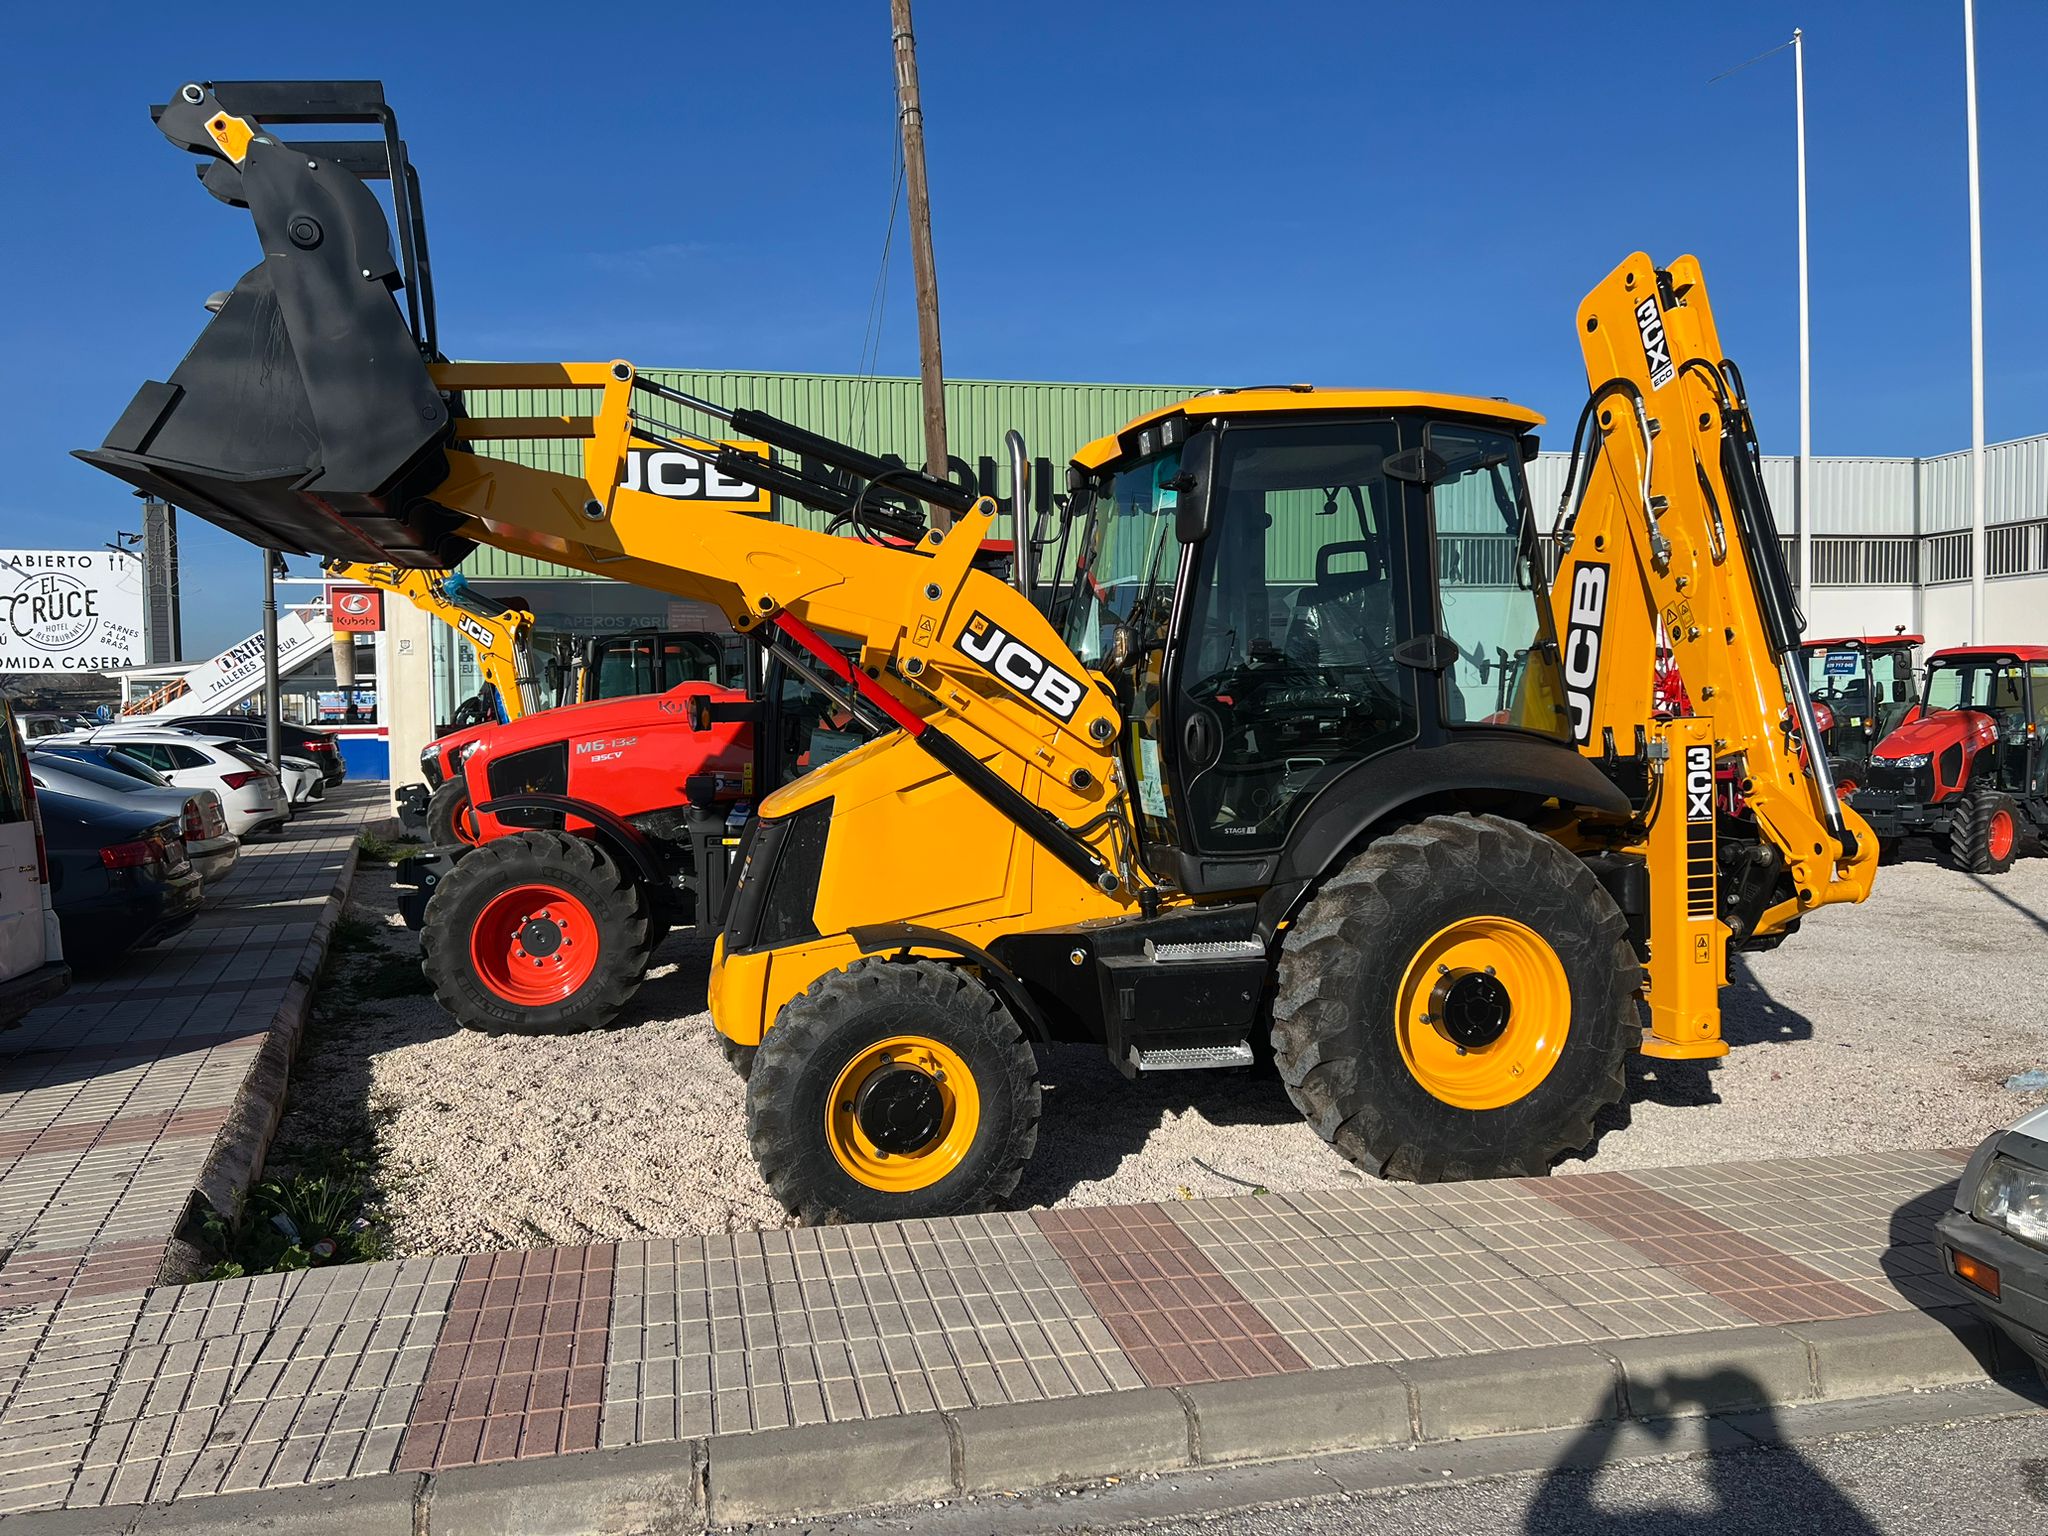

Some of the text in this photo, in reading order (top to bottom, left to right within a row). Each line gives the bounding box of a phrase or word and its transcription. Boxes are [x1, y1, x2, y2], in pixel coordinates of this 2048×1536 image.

[1637, 298, 1670, 373] 3CX
[1653, 368, 1673, 387] ECO
[10, 555, 92, 568] ABIERTO
[40, 575, 60, 595] EL
[1, 588, 99, 637] CRUCE
[336, 616, 376, 626] Kubota
[564, 616, 625, 627] APEROS
[629, 616, 669, 628] AGRI
[35, 621, 86, 643] RESTAURANTE
[45, 622, 69, 632] HOTEL
[103, 620, 140, 638] CARNES
[458, 617, 494, 648] JCB
[100, 636, 130, 652] BRASA
[115, 633, 127, 642] LA
[230, 633, 265, 659] INTER
[0, 656, 133, 669] MIDA CASERA
[235, 642, 266, 664] TALL
[1565, 567, 1606, 741] JCB
[209, 660, 257, 693] TALLERES
[960, 628, 1081, 717] JCB
[659, 700, 690, 714] Ku
[576, 736, 638, 754] M6-132
[1687, 747, 1712, 817] 3CX
[1224, 827, 1247, 835] STAGE
